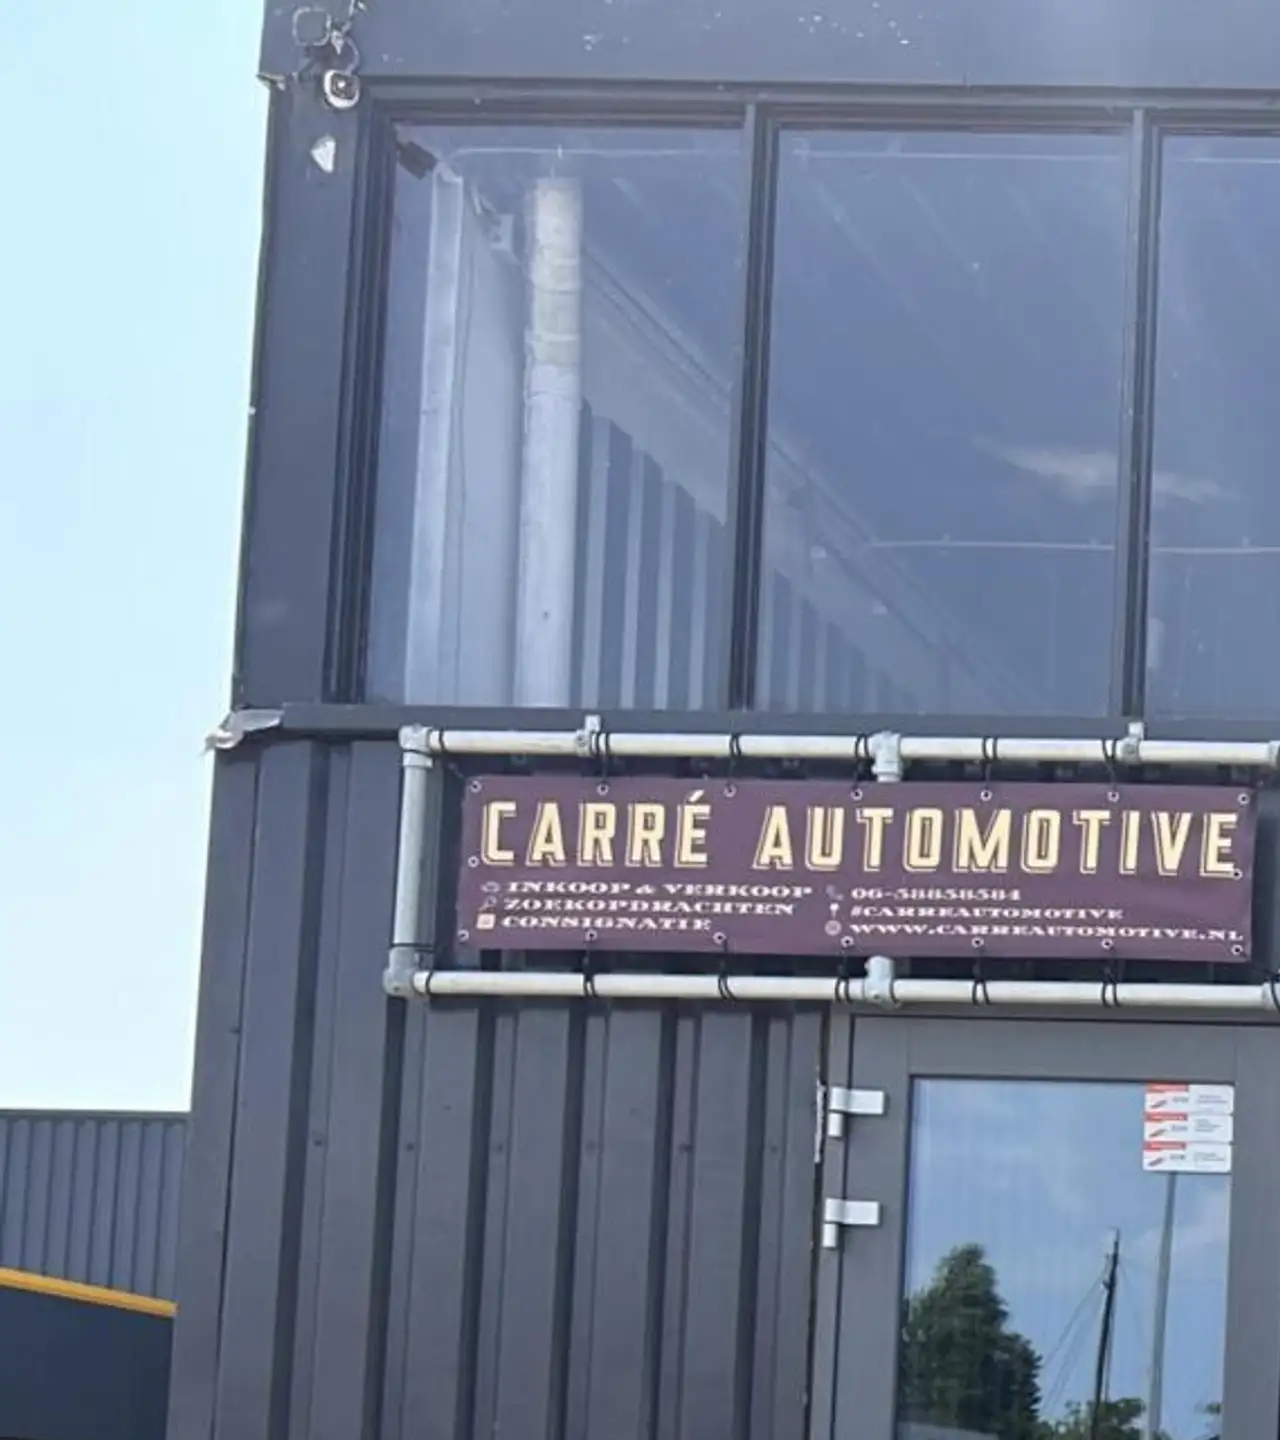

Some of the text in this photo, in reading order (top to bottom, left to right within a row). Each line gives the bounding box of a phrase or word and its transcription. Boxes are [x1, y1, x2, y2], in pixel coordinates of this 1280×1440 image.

[481, 789, 1240, 879] CARRÉ AUTOMOTIVE
[507, 881, 813, 898] INKOOP & VERKOOP
[503, 898, 796, 916] ZOEKOPDRACHTEN
[501, 915, 713, 931] CONSIGNATIE
[849, 923, 1245, 941] WWW.CARREAUTOMOTIVE.NL
